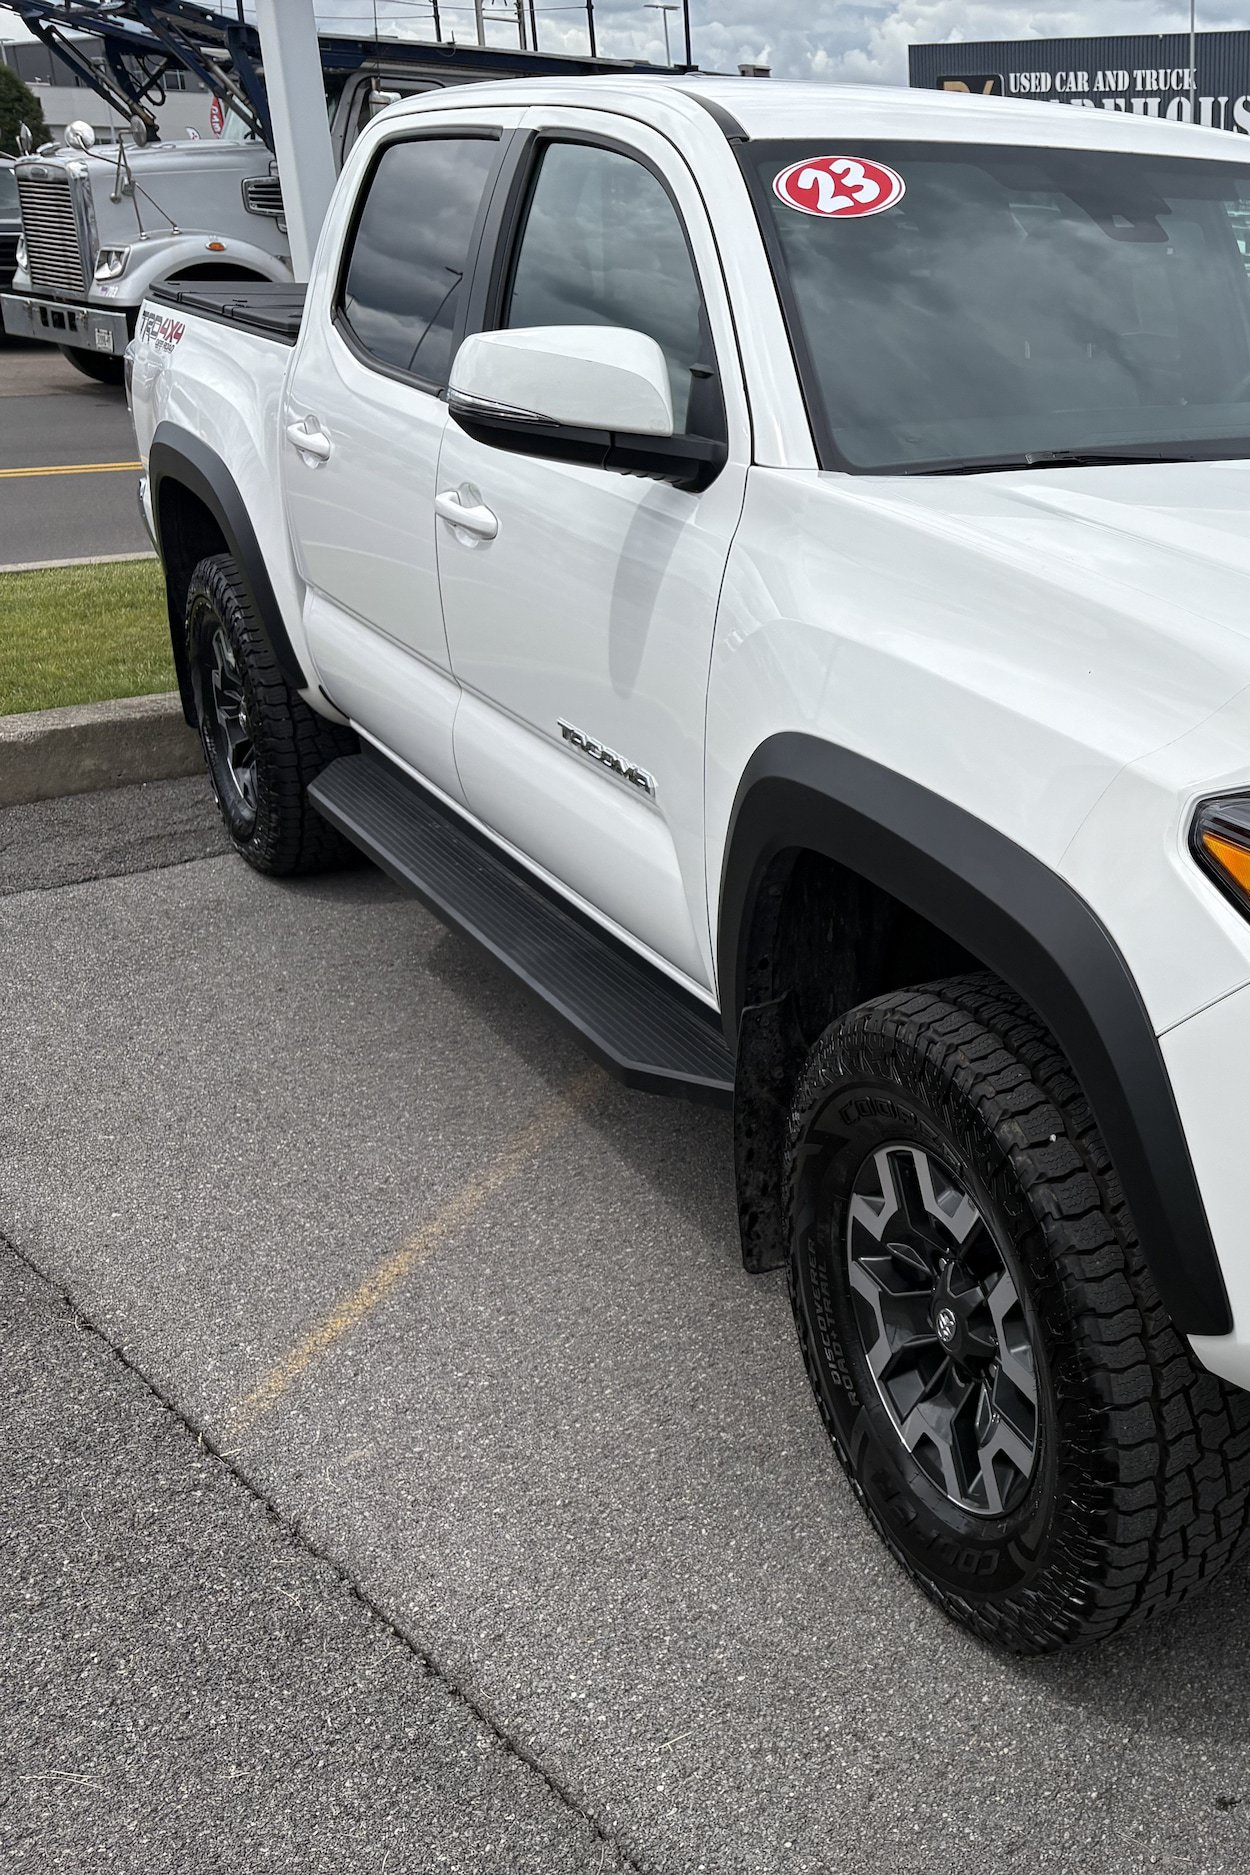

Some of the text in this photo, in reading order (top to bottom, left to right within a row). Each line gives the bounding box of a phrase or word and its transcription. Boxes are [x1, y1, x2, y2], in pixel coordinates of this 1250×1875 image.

[1009, 71, 1052, 94] USED
[1055, 71, 1090, 92] CAR
[1093, 69, 1130, 91] AND
[1133, 68, 1197, 91] TRUCK
[797, 159, 881, 213] 23
[557, 716, 657, 796] TACOMA
[807, 1237, 842, 1386] DISCOVERER
